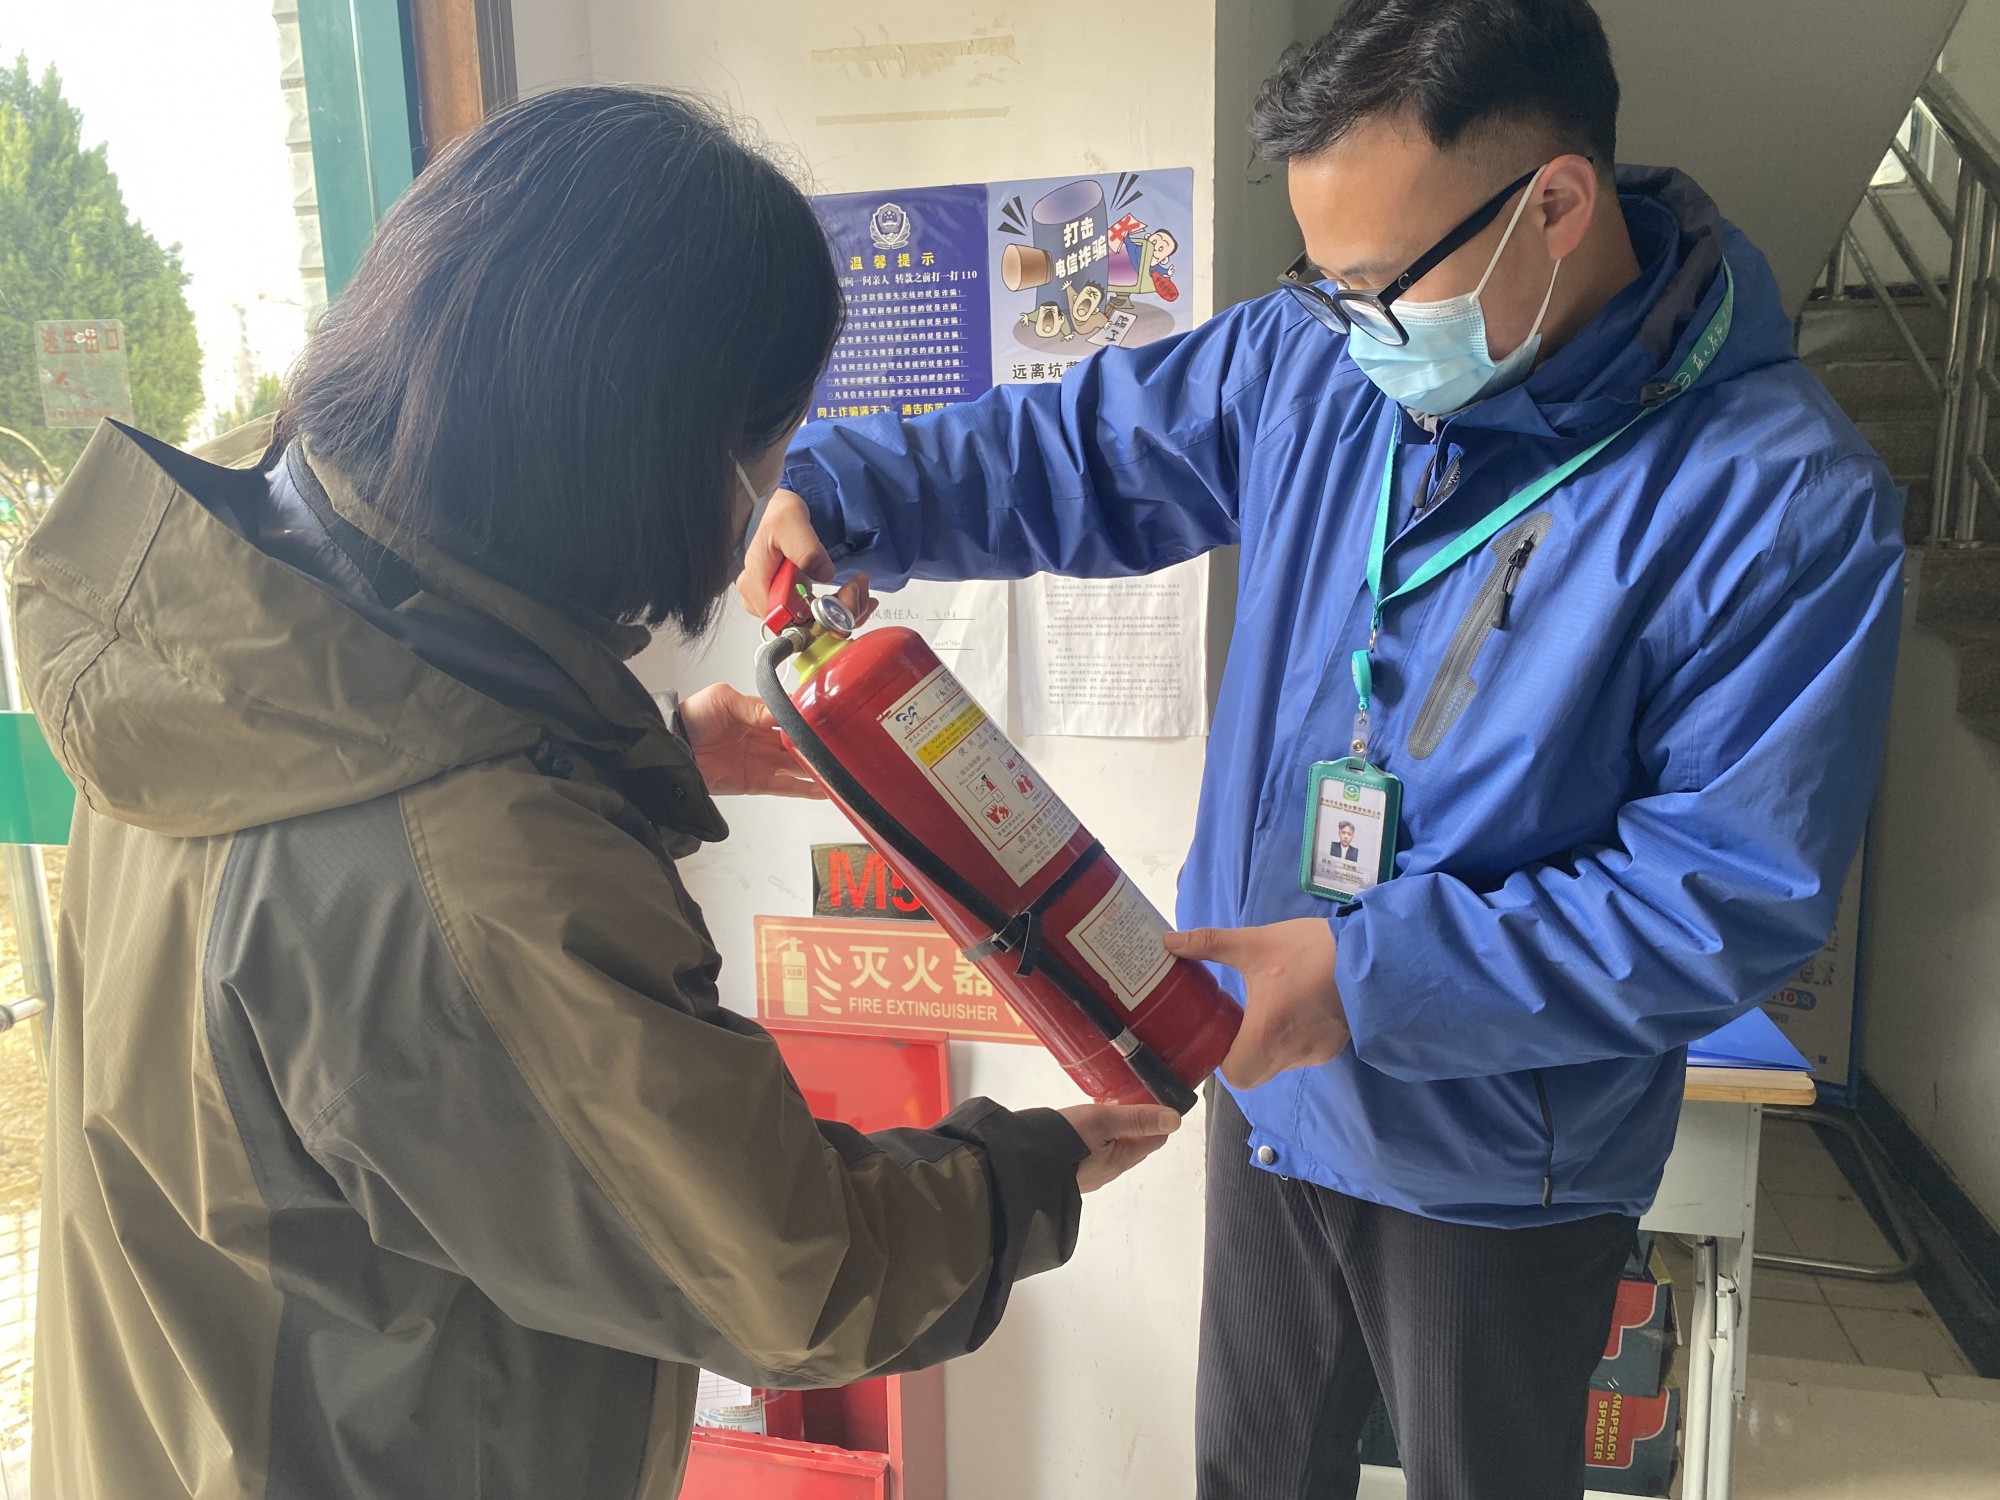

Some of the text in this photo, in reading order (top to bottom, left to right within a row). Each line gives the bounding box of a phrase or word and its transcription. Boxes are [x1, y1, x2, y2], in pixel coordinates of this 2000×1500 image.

[1063, 216, 1094, 248] 打击
[850, 252, 935, 271] 温馨提示
[961, 270, 978, 280] 110
[1055, 235, 1108, 279] 电信诈骗
[849, 945, 993, 997] 灭火器
[849, 997, 998, 1021] FIRE EXTINGUISHER
[1593, 1400, 1608, 1460] SPRAYER
[1606, 1393, 1623, 1461] KNAPSACK
